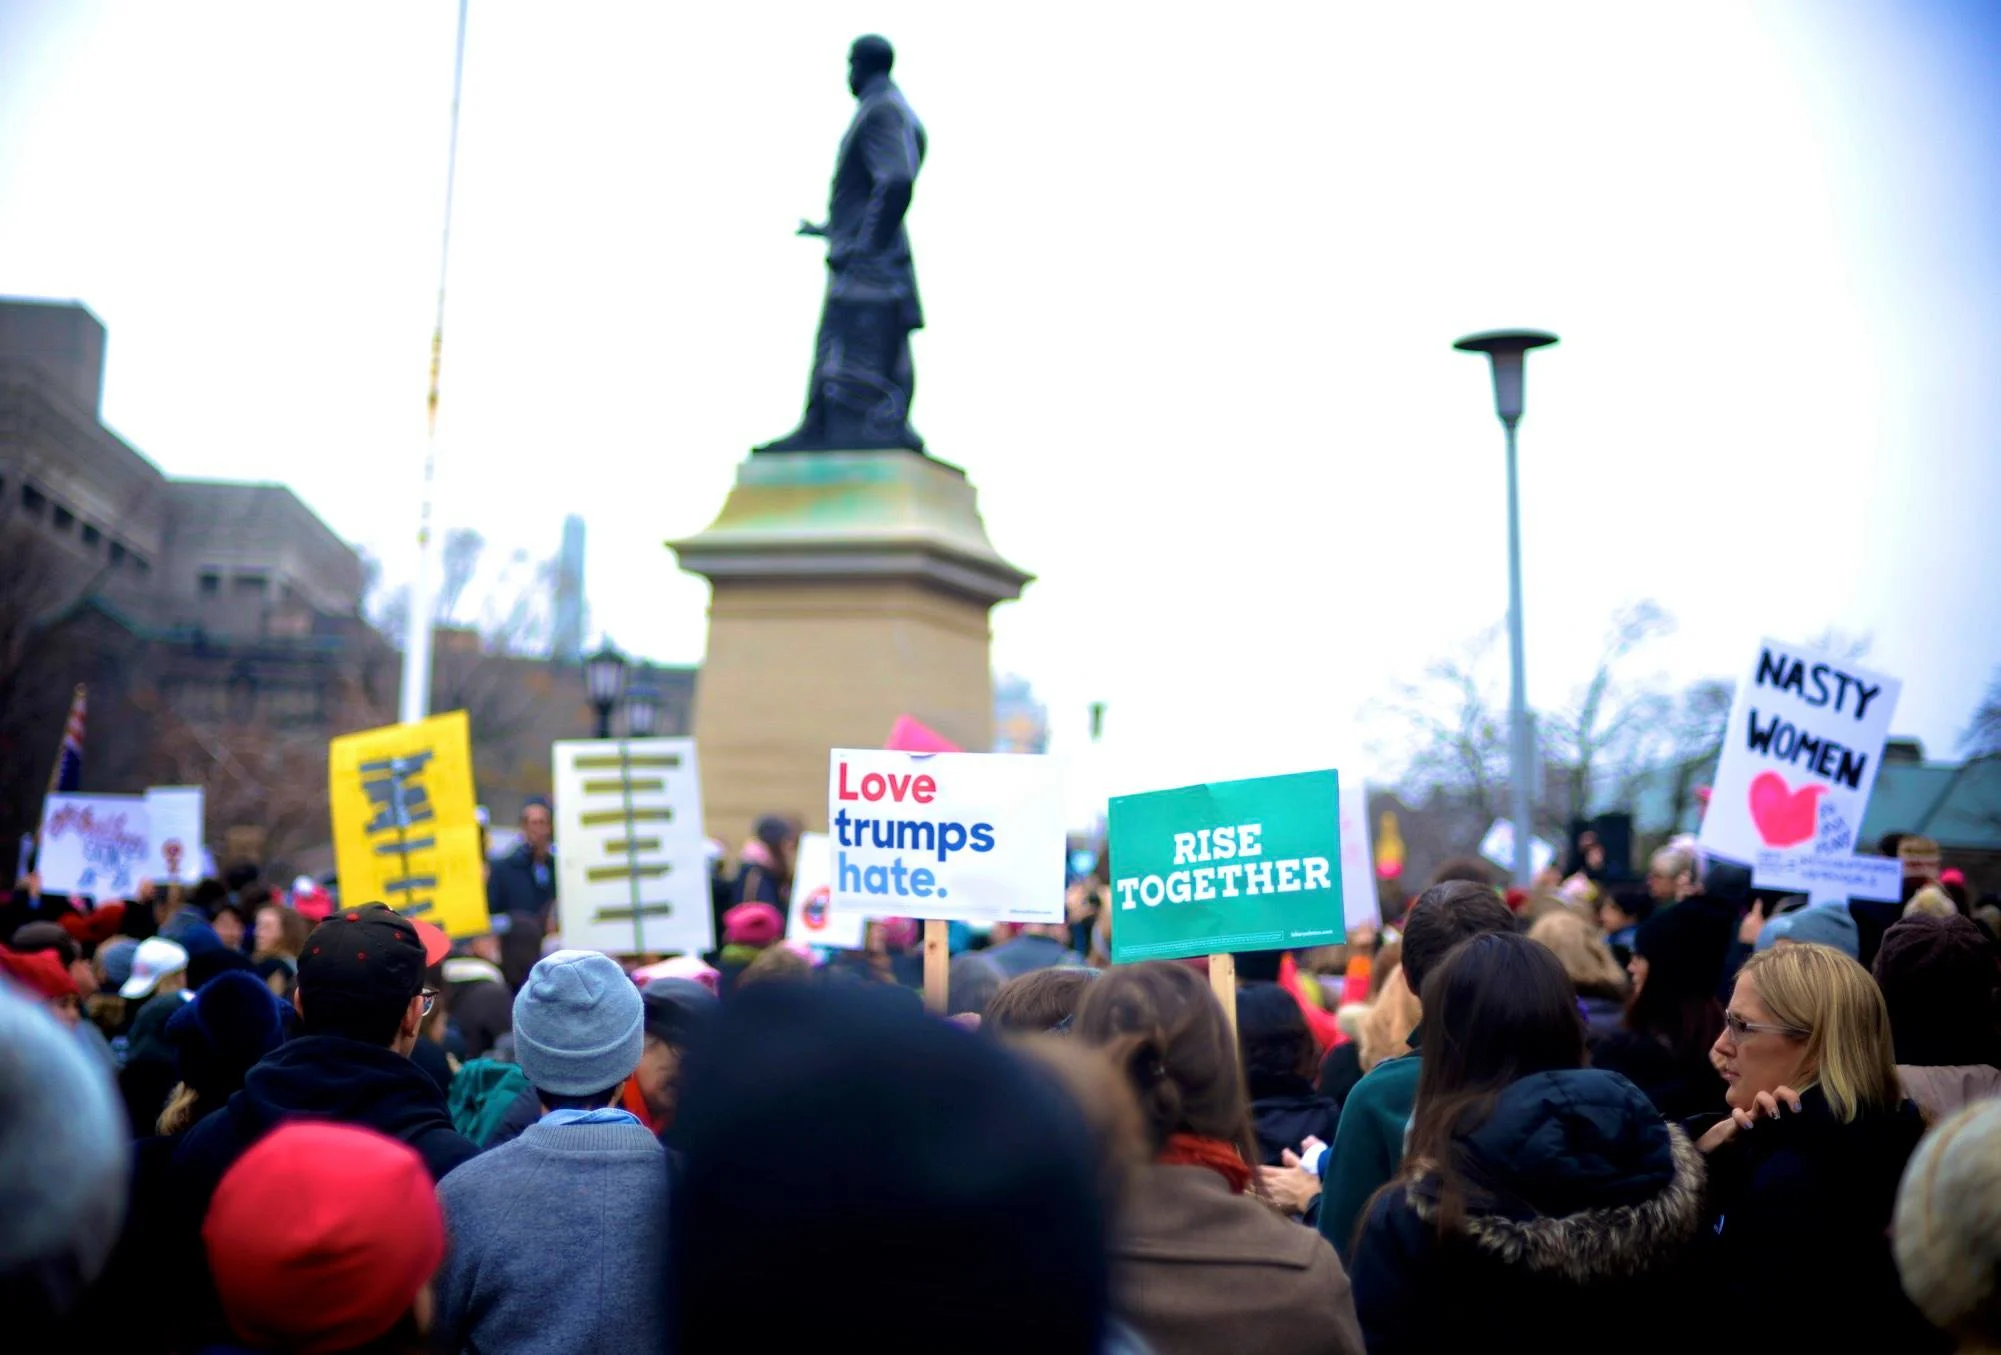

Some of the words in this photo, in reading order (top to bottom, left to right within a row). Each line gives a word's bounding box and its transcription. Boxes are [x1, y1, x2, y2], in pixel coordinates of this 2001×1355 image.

[1757, 648, 1880, 720] NASTY
[1748, 708, 1867, 790] WOMEN
[838, 762, 937, 804] Love
[834, 808, 996, 862] trumps
[1173, 823, 1262, 864] RISE
[838, 851, 949, 898] hate.
[1117, 857, 1331, 910] TOGETHER
